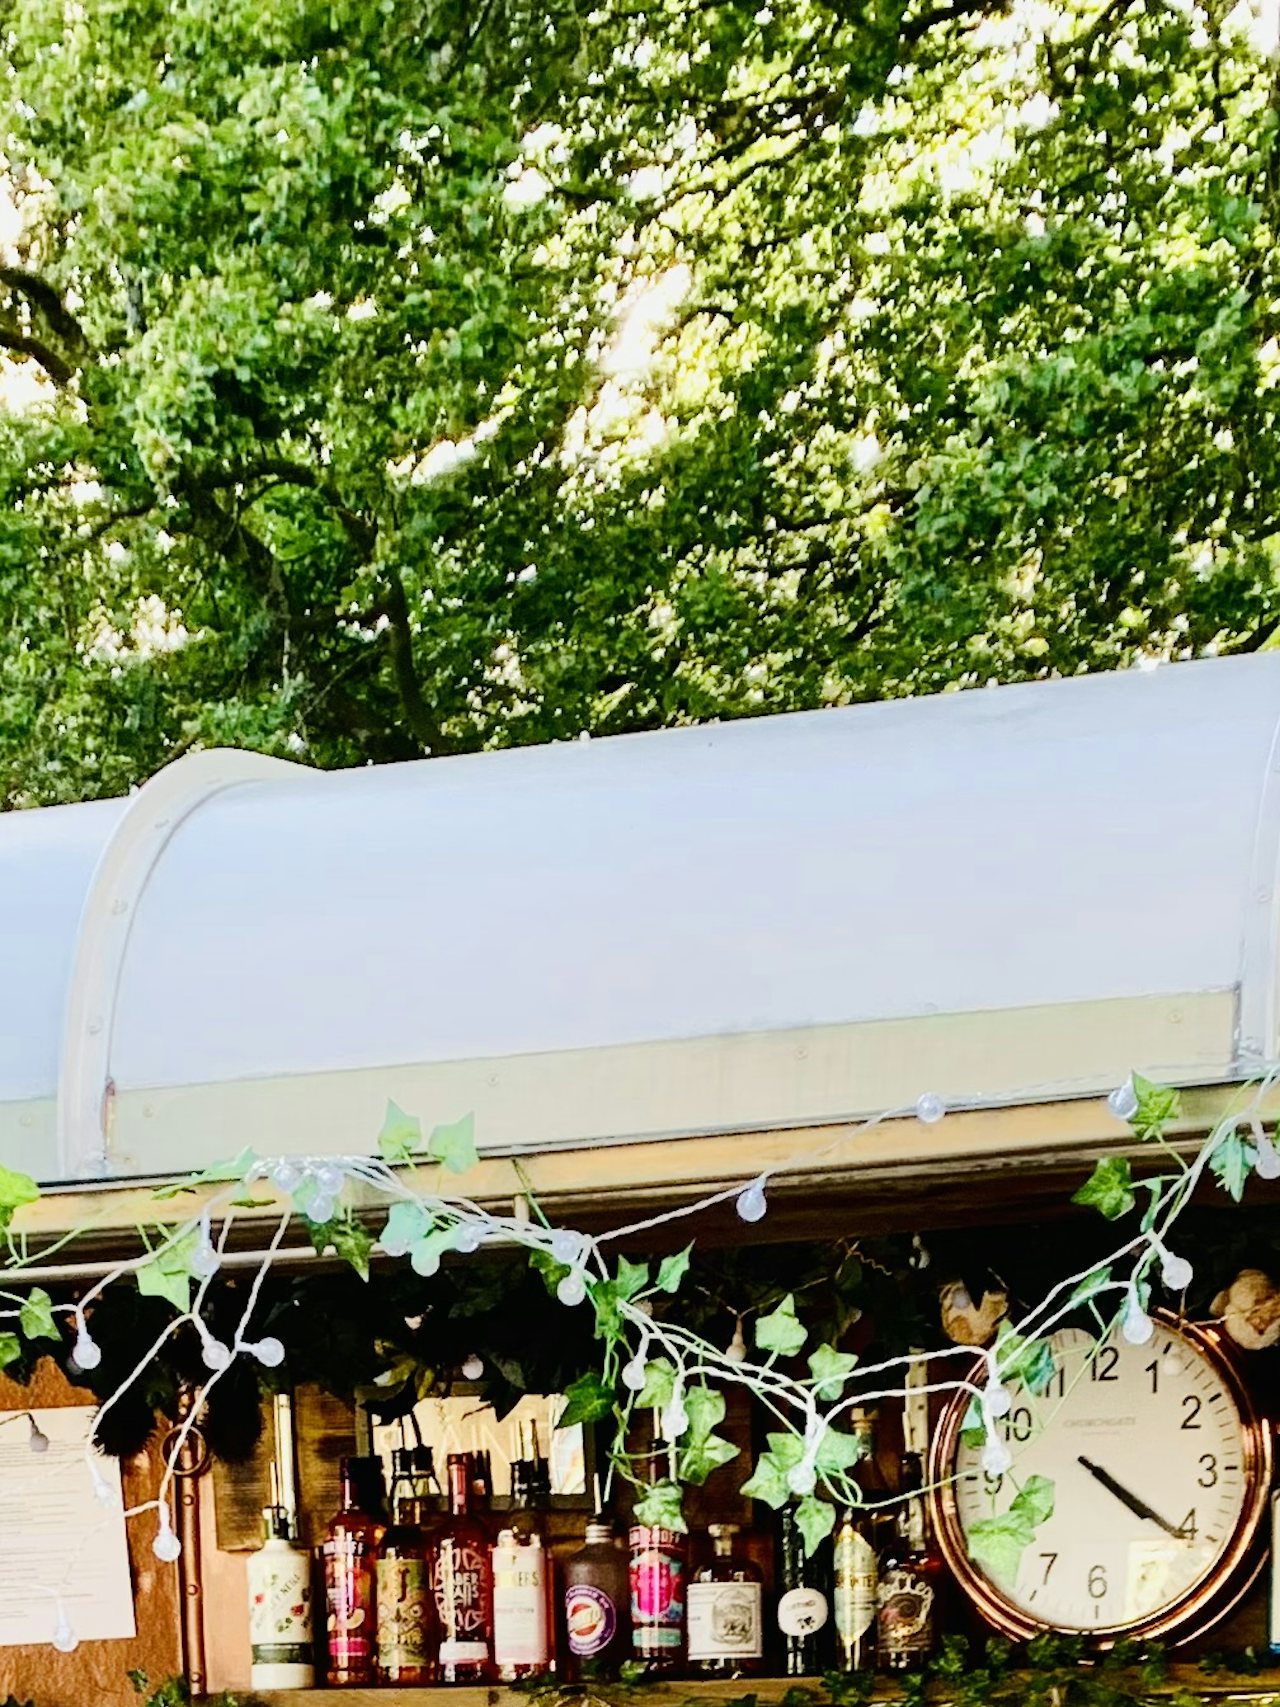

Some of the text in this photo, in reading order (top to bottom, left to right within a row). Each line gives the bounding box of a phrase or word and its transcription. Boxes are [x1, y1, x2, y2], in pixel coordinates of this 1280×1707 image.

[1084, 1347, 1118, 1381] 12
[1146, 1360, 1158, 1393] 1
[1000, 1407, 1032, 1442] 10
[1181, 1395, 1201, 1430] 2
[1198, 1454, 1217, 1487] 3
[1177, 1508, 1199, 1547] 4
[1040, 1553, 1058, 1585] 7
[1088, 1565, 1107, 1598] 6
